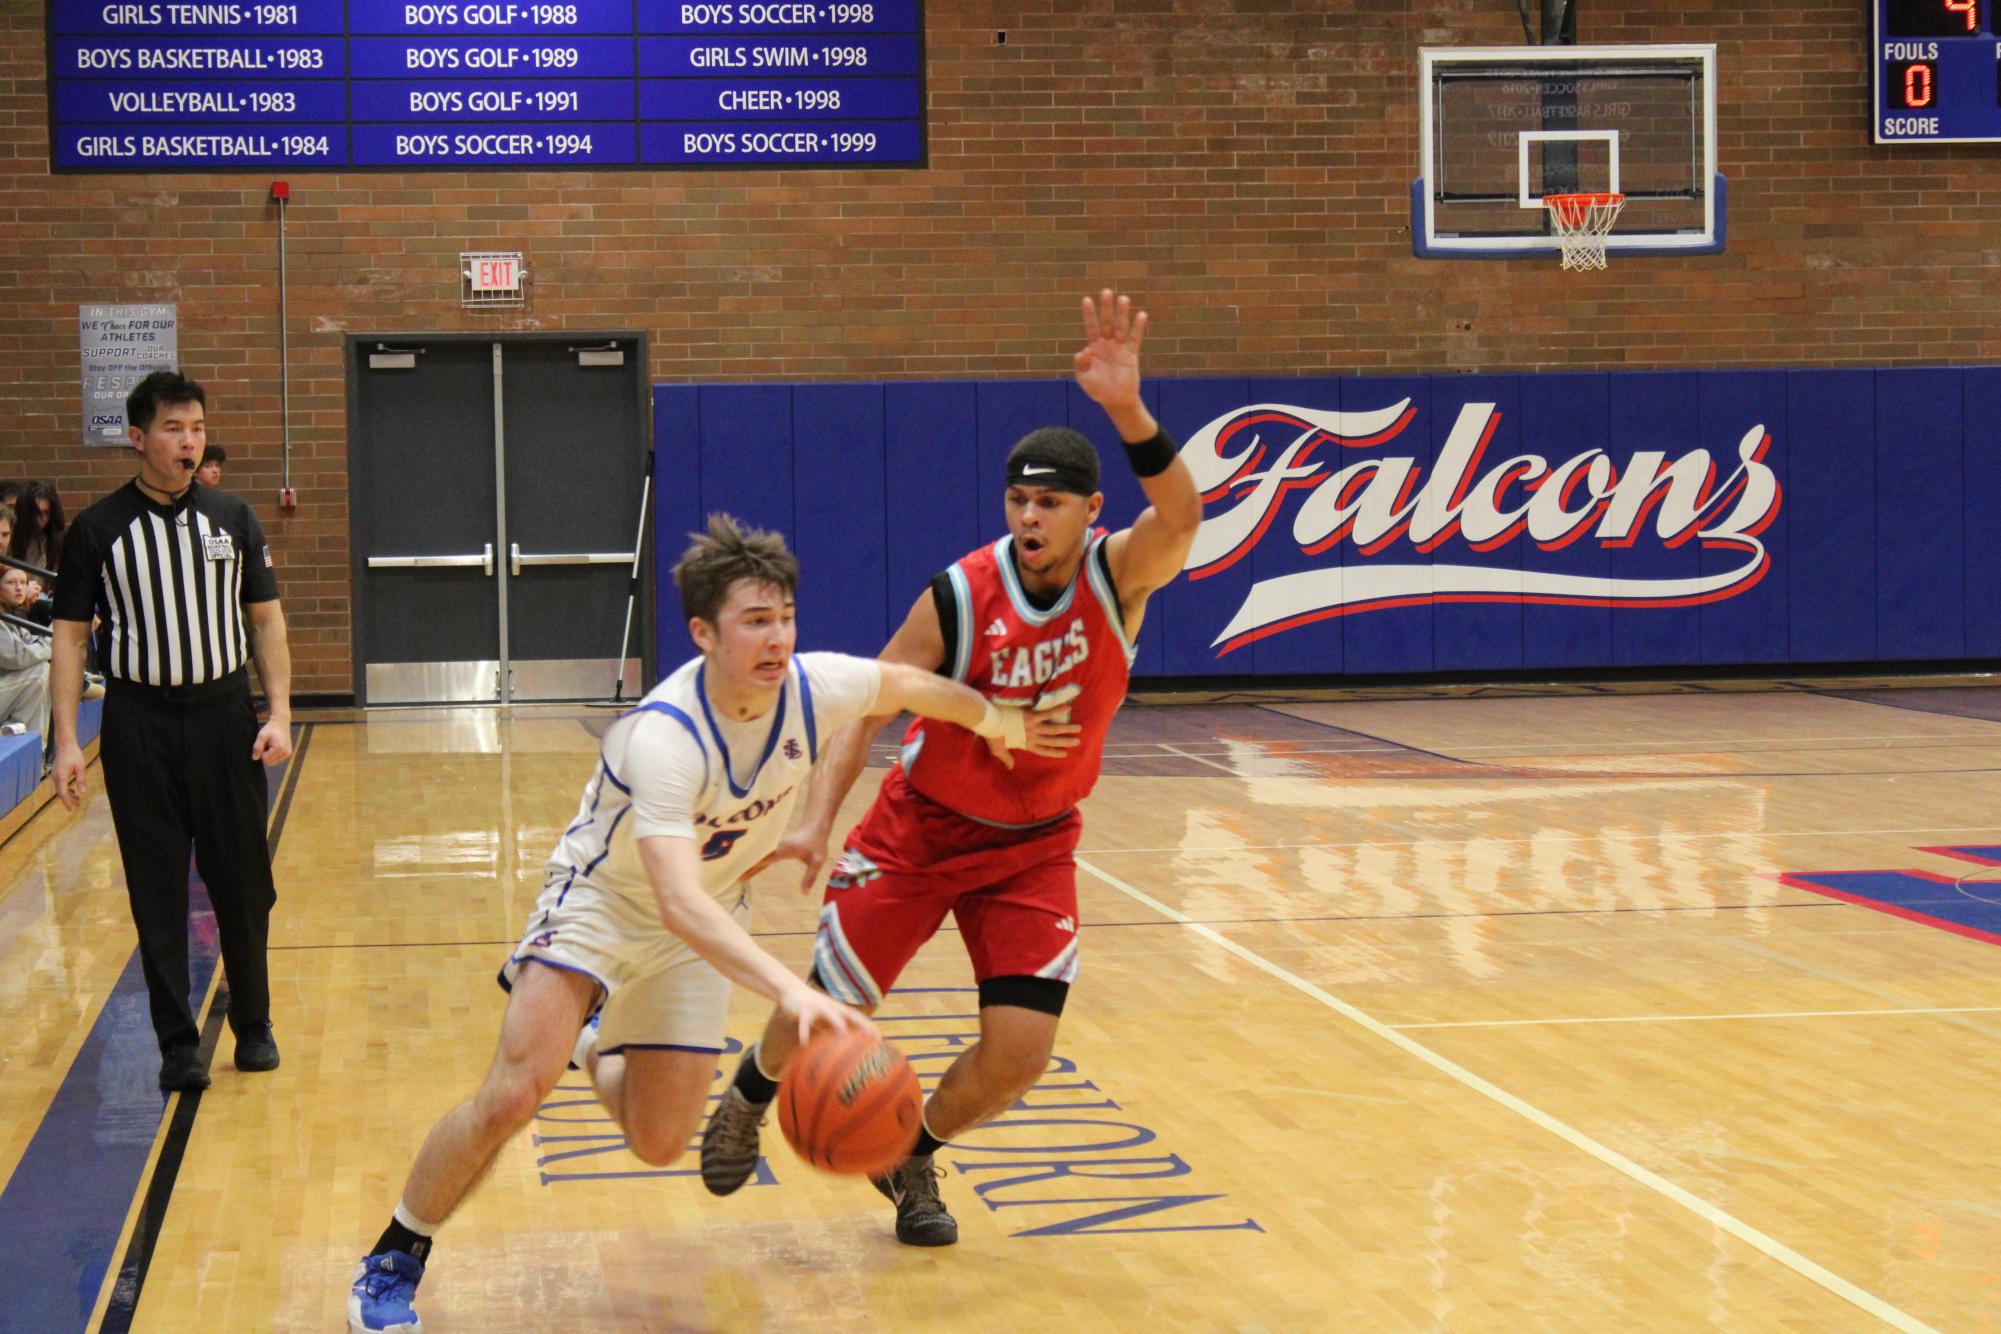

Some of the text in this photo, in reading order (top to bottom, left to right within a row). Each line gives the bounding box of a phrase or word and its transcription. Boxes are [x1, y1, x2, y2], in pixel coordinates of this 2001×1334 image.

[102, 4, 162, 25] GIRLS
[405, 4, 459, 26] BOYS
[681, 4, 734, 25] BOYS
[77, 48, 132, 69] BOYS
[406, 47, 460, 69] BOYS
[689, 47, 747, 68] GIRLS
[1884, 42, 1939, 60] FOULS
[1905, 64, 1931, 107] 0
[409, 91, 463, 112] BOYS
[1884, 117, 1940, 136] SCORE
[76, 136, 137, 157] GIRLS
[396, 134, 450, 156] BOYS
[683, 133, 736, 154] BOYS
[480, 261, 513, 287] EXIT
[140, 307, 167, 317] GYM
[81, 321, 98, 330] WE
[128, 320, 150, 330] FOR
[152, 320, 175, 329] OUR
[101, 332, 156, 342] ATHLETES
[82, 347, 137, 358] SUPPORT
[136, 352, 176, 360] COACHES
[83, 375, 137, 391] RESP
[94, 391, 114, 399] OUR
[91, 415, 123, 425] OSAA
[1178, 396, 1784, 658] Falcons
